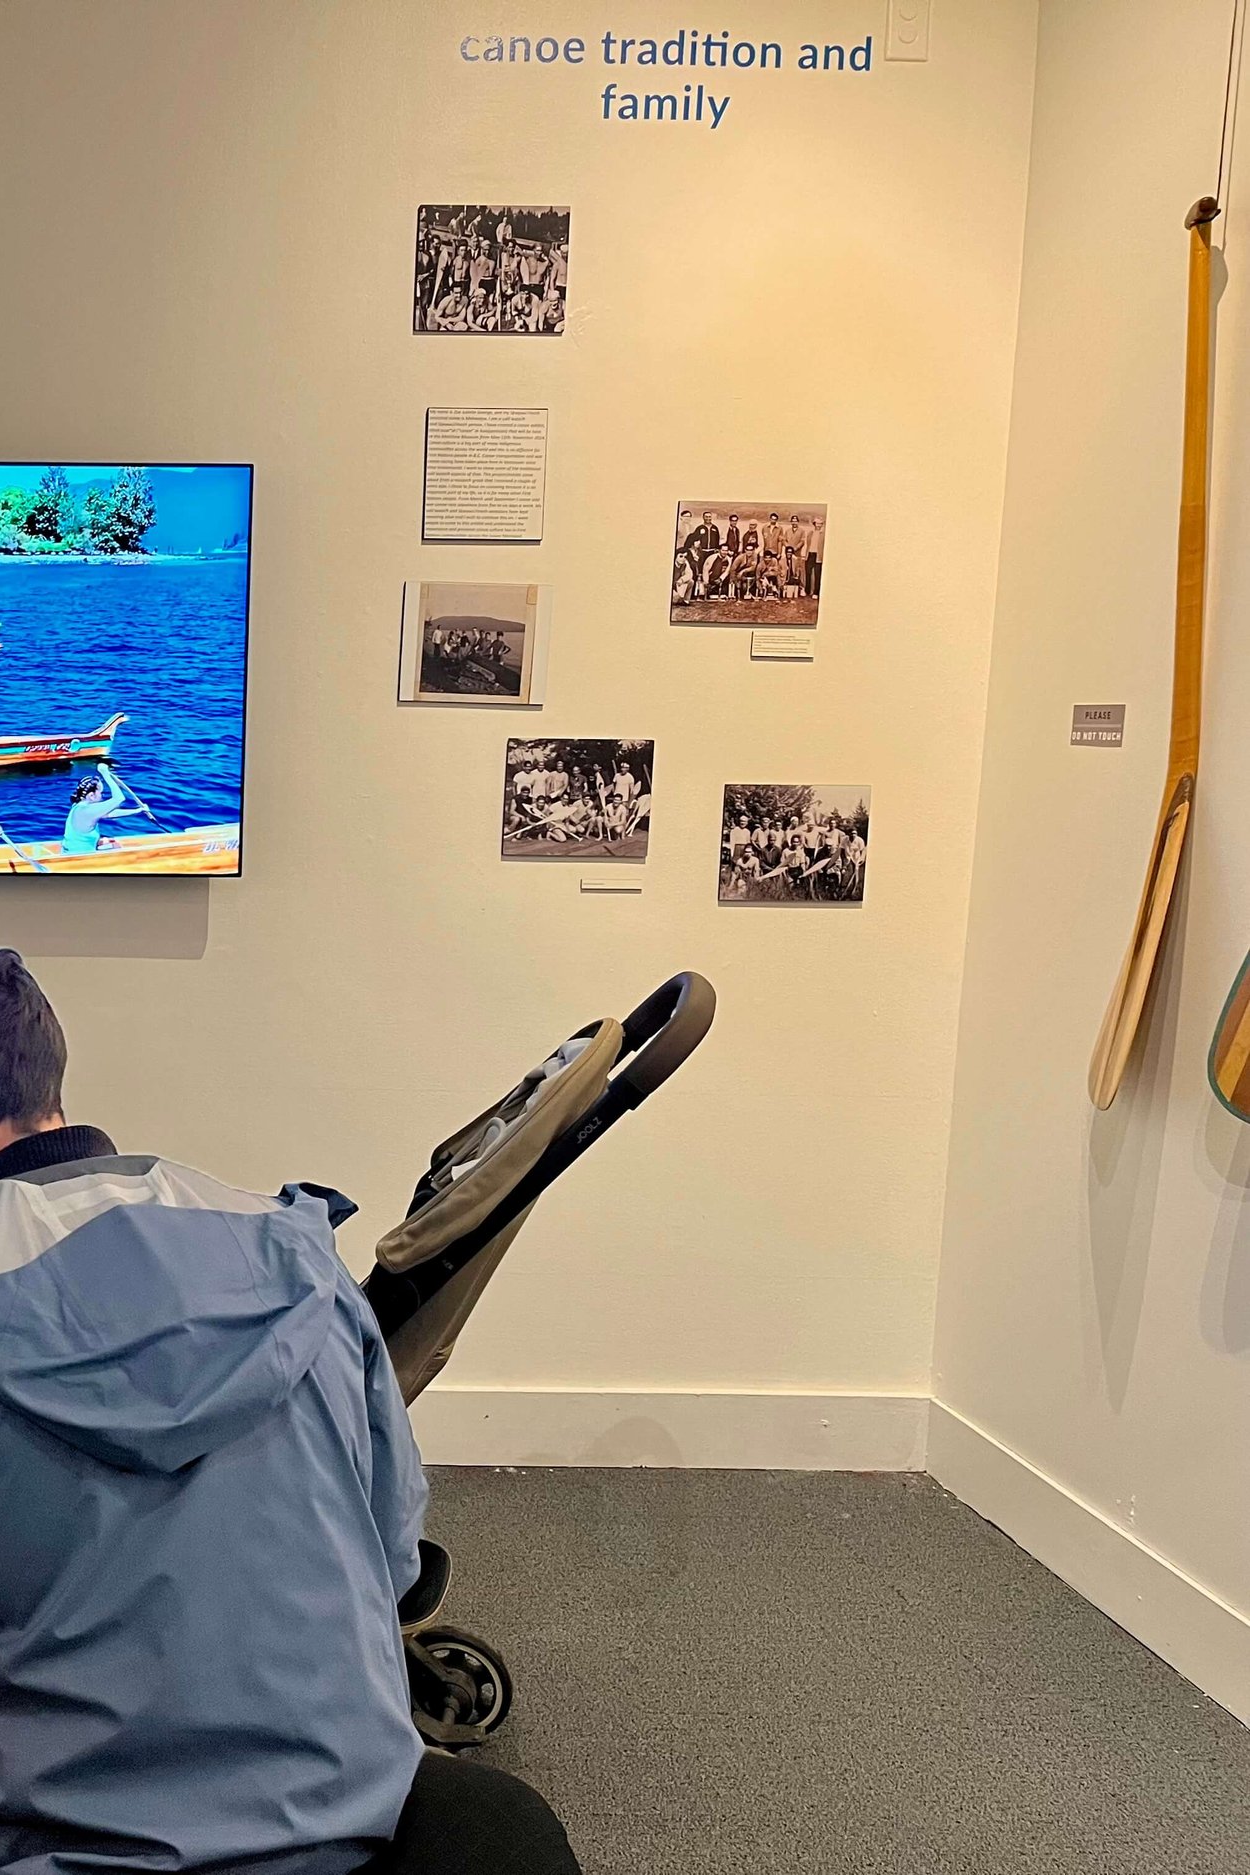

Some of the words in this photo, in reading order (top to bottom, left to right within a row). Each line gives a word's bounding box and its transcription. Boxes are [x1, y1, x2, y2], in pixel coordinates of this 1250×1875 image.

[460, 36, 585, 64] canoe
[600, 29, 782, 69] tradition
[797, 35, 873, 72] and
[600, 83, 731, 130] family
[1084, 711, 1112, 720] PLEASE
[1071, 731, 1081, 741] DO
[1082, 731, 1096, 741] NOT
[1098, 731, 1122, 741] TOUCH
[576, 1116, 603, 1145] JOOLZ
